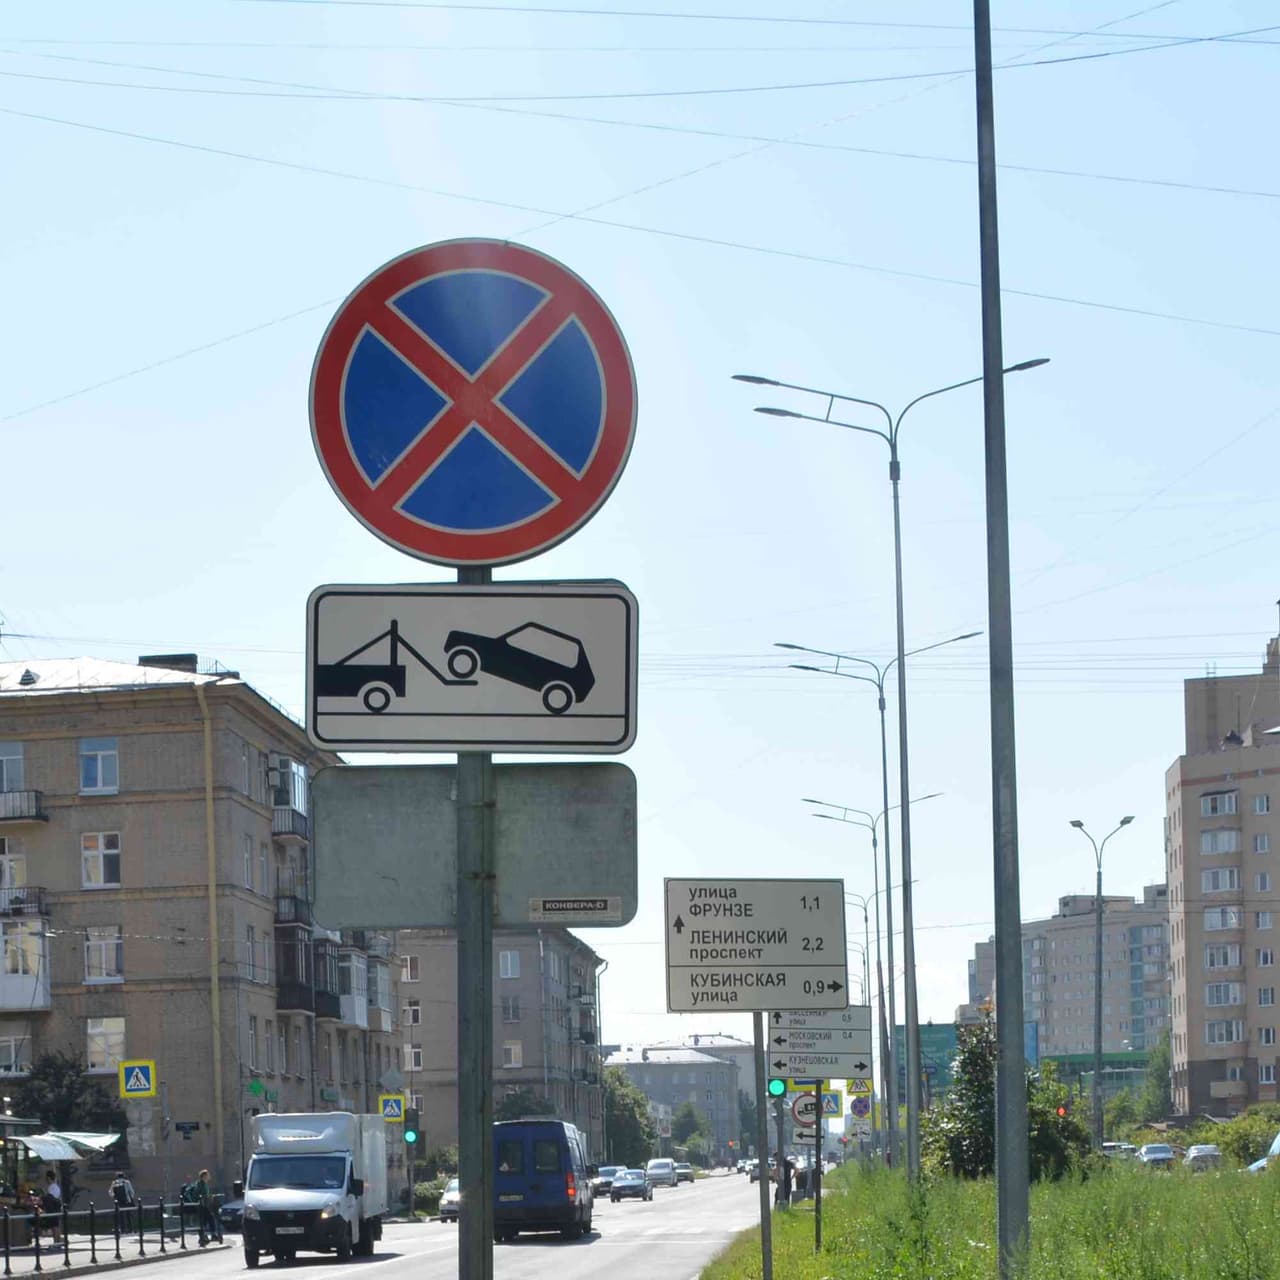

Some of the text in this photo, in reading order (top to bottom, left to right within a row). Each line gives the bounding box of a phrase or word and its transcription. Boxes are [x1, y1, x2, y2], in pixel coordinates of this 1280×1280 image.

[689, 887, 737, 901] улица
[689, 903, 753, 917] ФРУНЗЕ
[800, 896, 820, 912] 1,1
[690, 928, 788, 945] ЛЕНИНСКИЙ
[802, 937, 824, 955] 2,2
[690, 948, 763, 962] проспект
[690, 973, 786, 988] КУБИНСКАЯ
[803, 980, 825, 996] 0,9
[691, 991, 738, 1006] улица
[789, 1031, 832, 1040] МОСКОВСКИЙ
